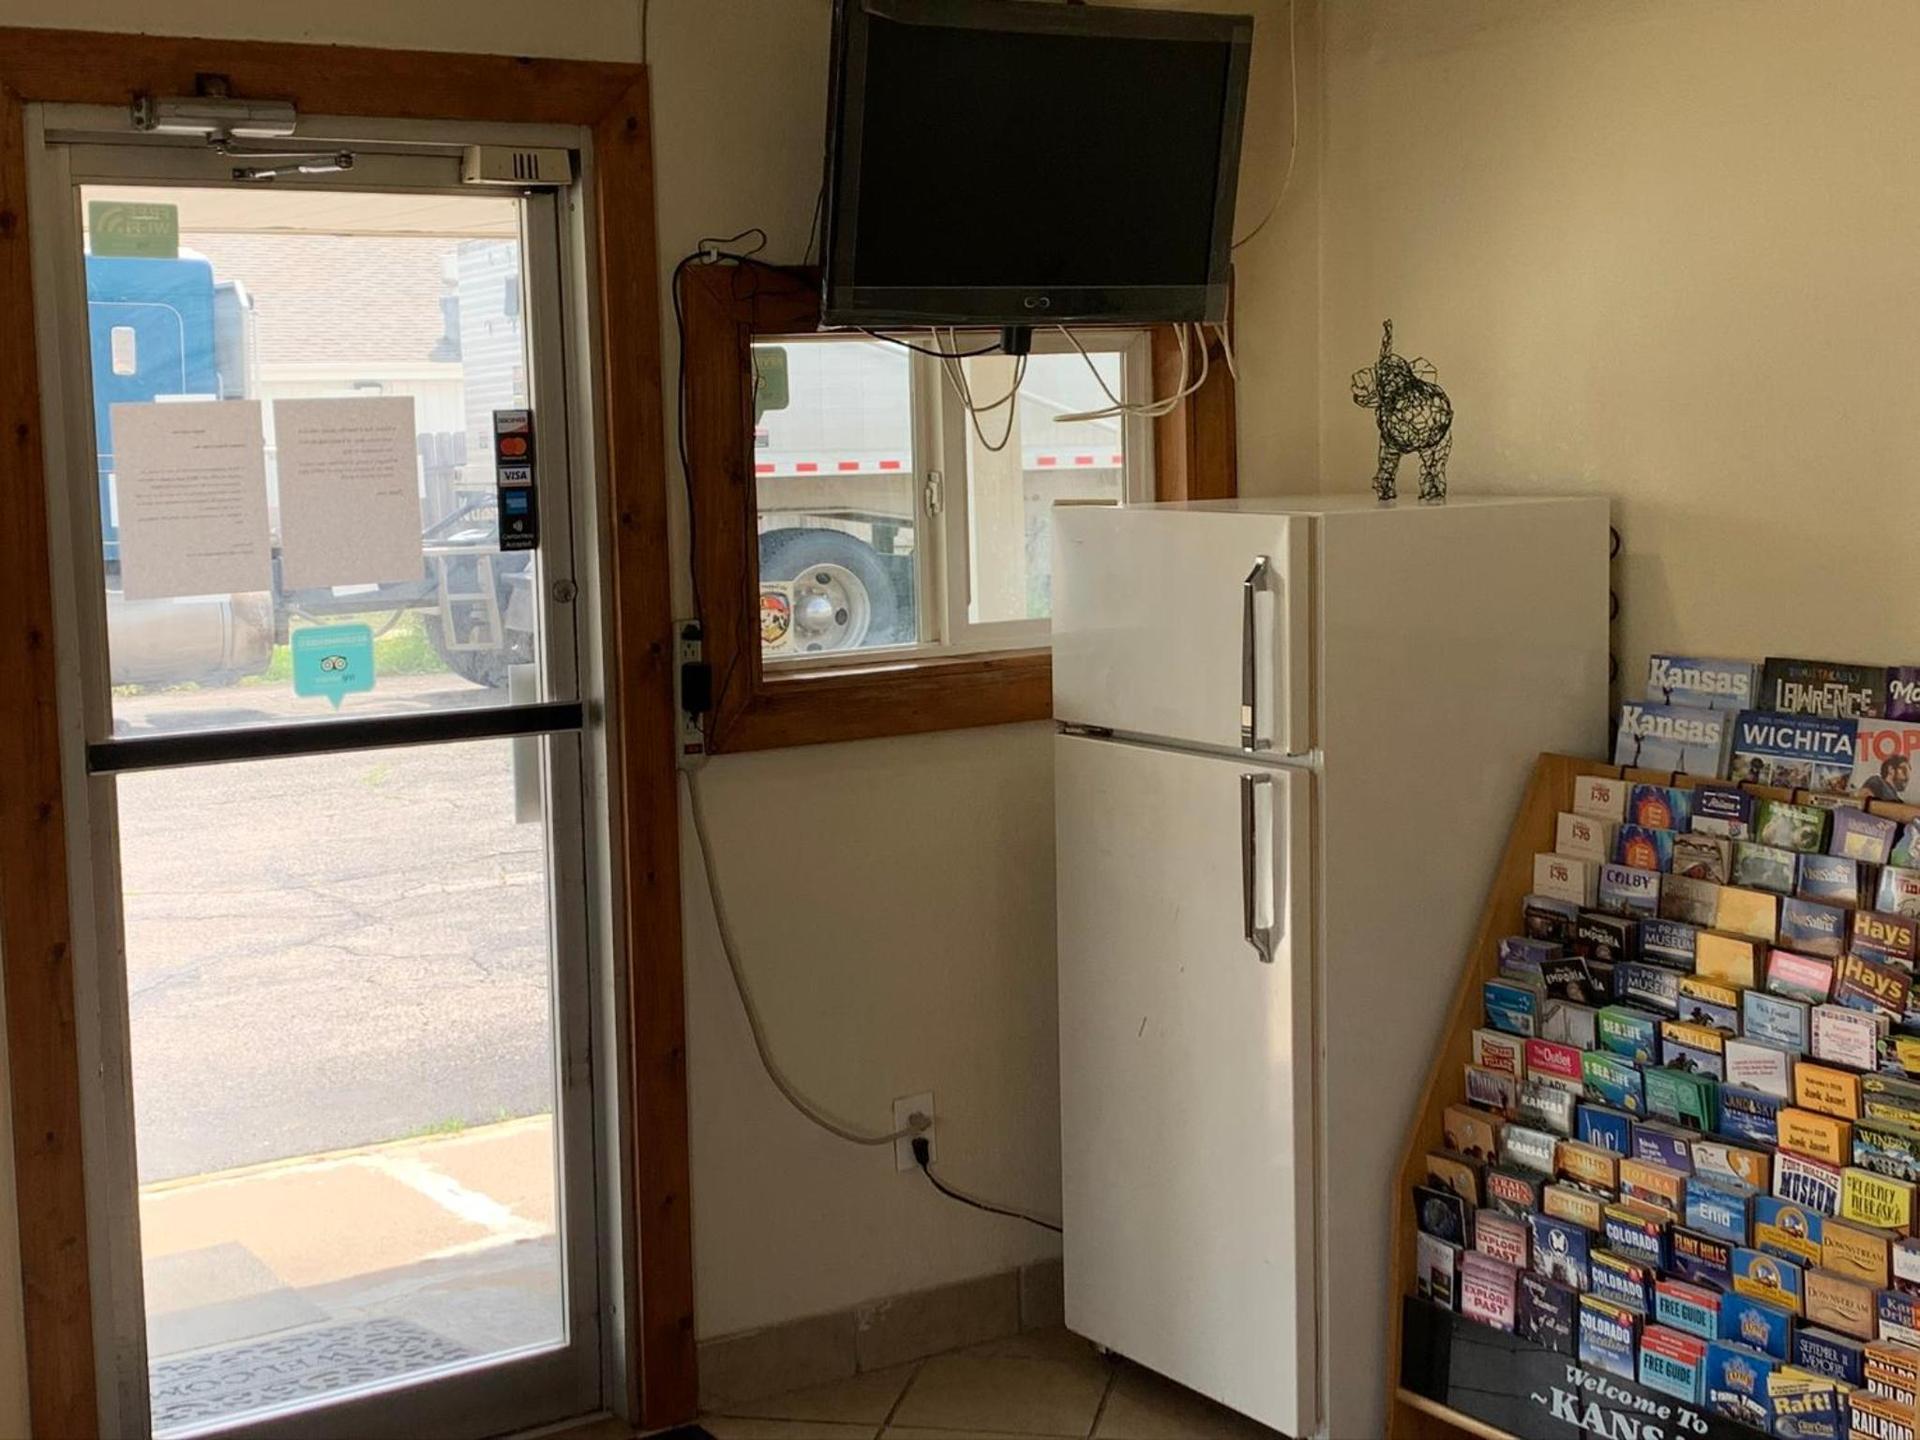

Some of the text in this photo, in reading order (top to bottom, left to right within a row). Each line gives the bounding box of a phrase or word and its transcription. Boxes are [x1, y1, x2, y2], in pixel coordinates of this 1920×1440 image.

[504, 471, 528, 480] VISA
[1650, 658, 1748, 695] Kansas
[1776, 678, 1872, 718] LAWRENCE
[1622, 705, 1721, 745] Kansas
[1743, 723, 1852, 756] WICHITA
[1606, 870, 1650, 890] COLBY
[1854, 913, 1911, 945] Hays
[1846, 956, 1903, 998] Hays
[1507, 1139, 1550, 1159] KANSAS
[1860, 1130, 1911, 1150] WINERY
[1782, 1157, 1800, 1172] FORT
[1779, 1171, 1837, 1218] MUSEUM
[1851, 1178, 1896, 1202] KEARNEY
[1700, 1203, 1731, 1227] Enid
[1851, 1197, 1900, 1224] NEBRASKA
[1477, 1234, 1522, 1252] EXPLORE
[1606, 1222, 1659, 1253] COLORADO
[1674, 1234, 1728, 1265] FLINT HILLS
[1823, 1238, 1884, 1263] DOWNSTREAM
[1487, 1246, 1519, 1263] PAST
[1464, 1284, 1509, 1306] EXPLORE
[1592, 1266, 1643, 1298] COLORADO
[1474, 1298, 1505, 1316] PAST
[1660, 1297, 1706, 1328] FREE GUIDE
[1807, 1286, 1868, 1314] DOWNSTREAM
[1580, 1310, 1631, 1344] COLORADO
[1643, 1353, 1692, 1385] FREE GUIDE
[1566, 1364, 1671, 1420] Welcome
[1676, 1407, 1709, 1435] To
[1773, 1392, 1832, 1415] Raft!
